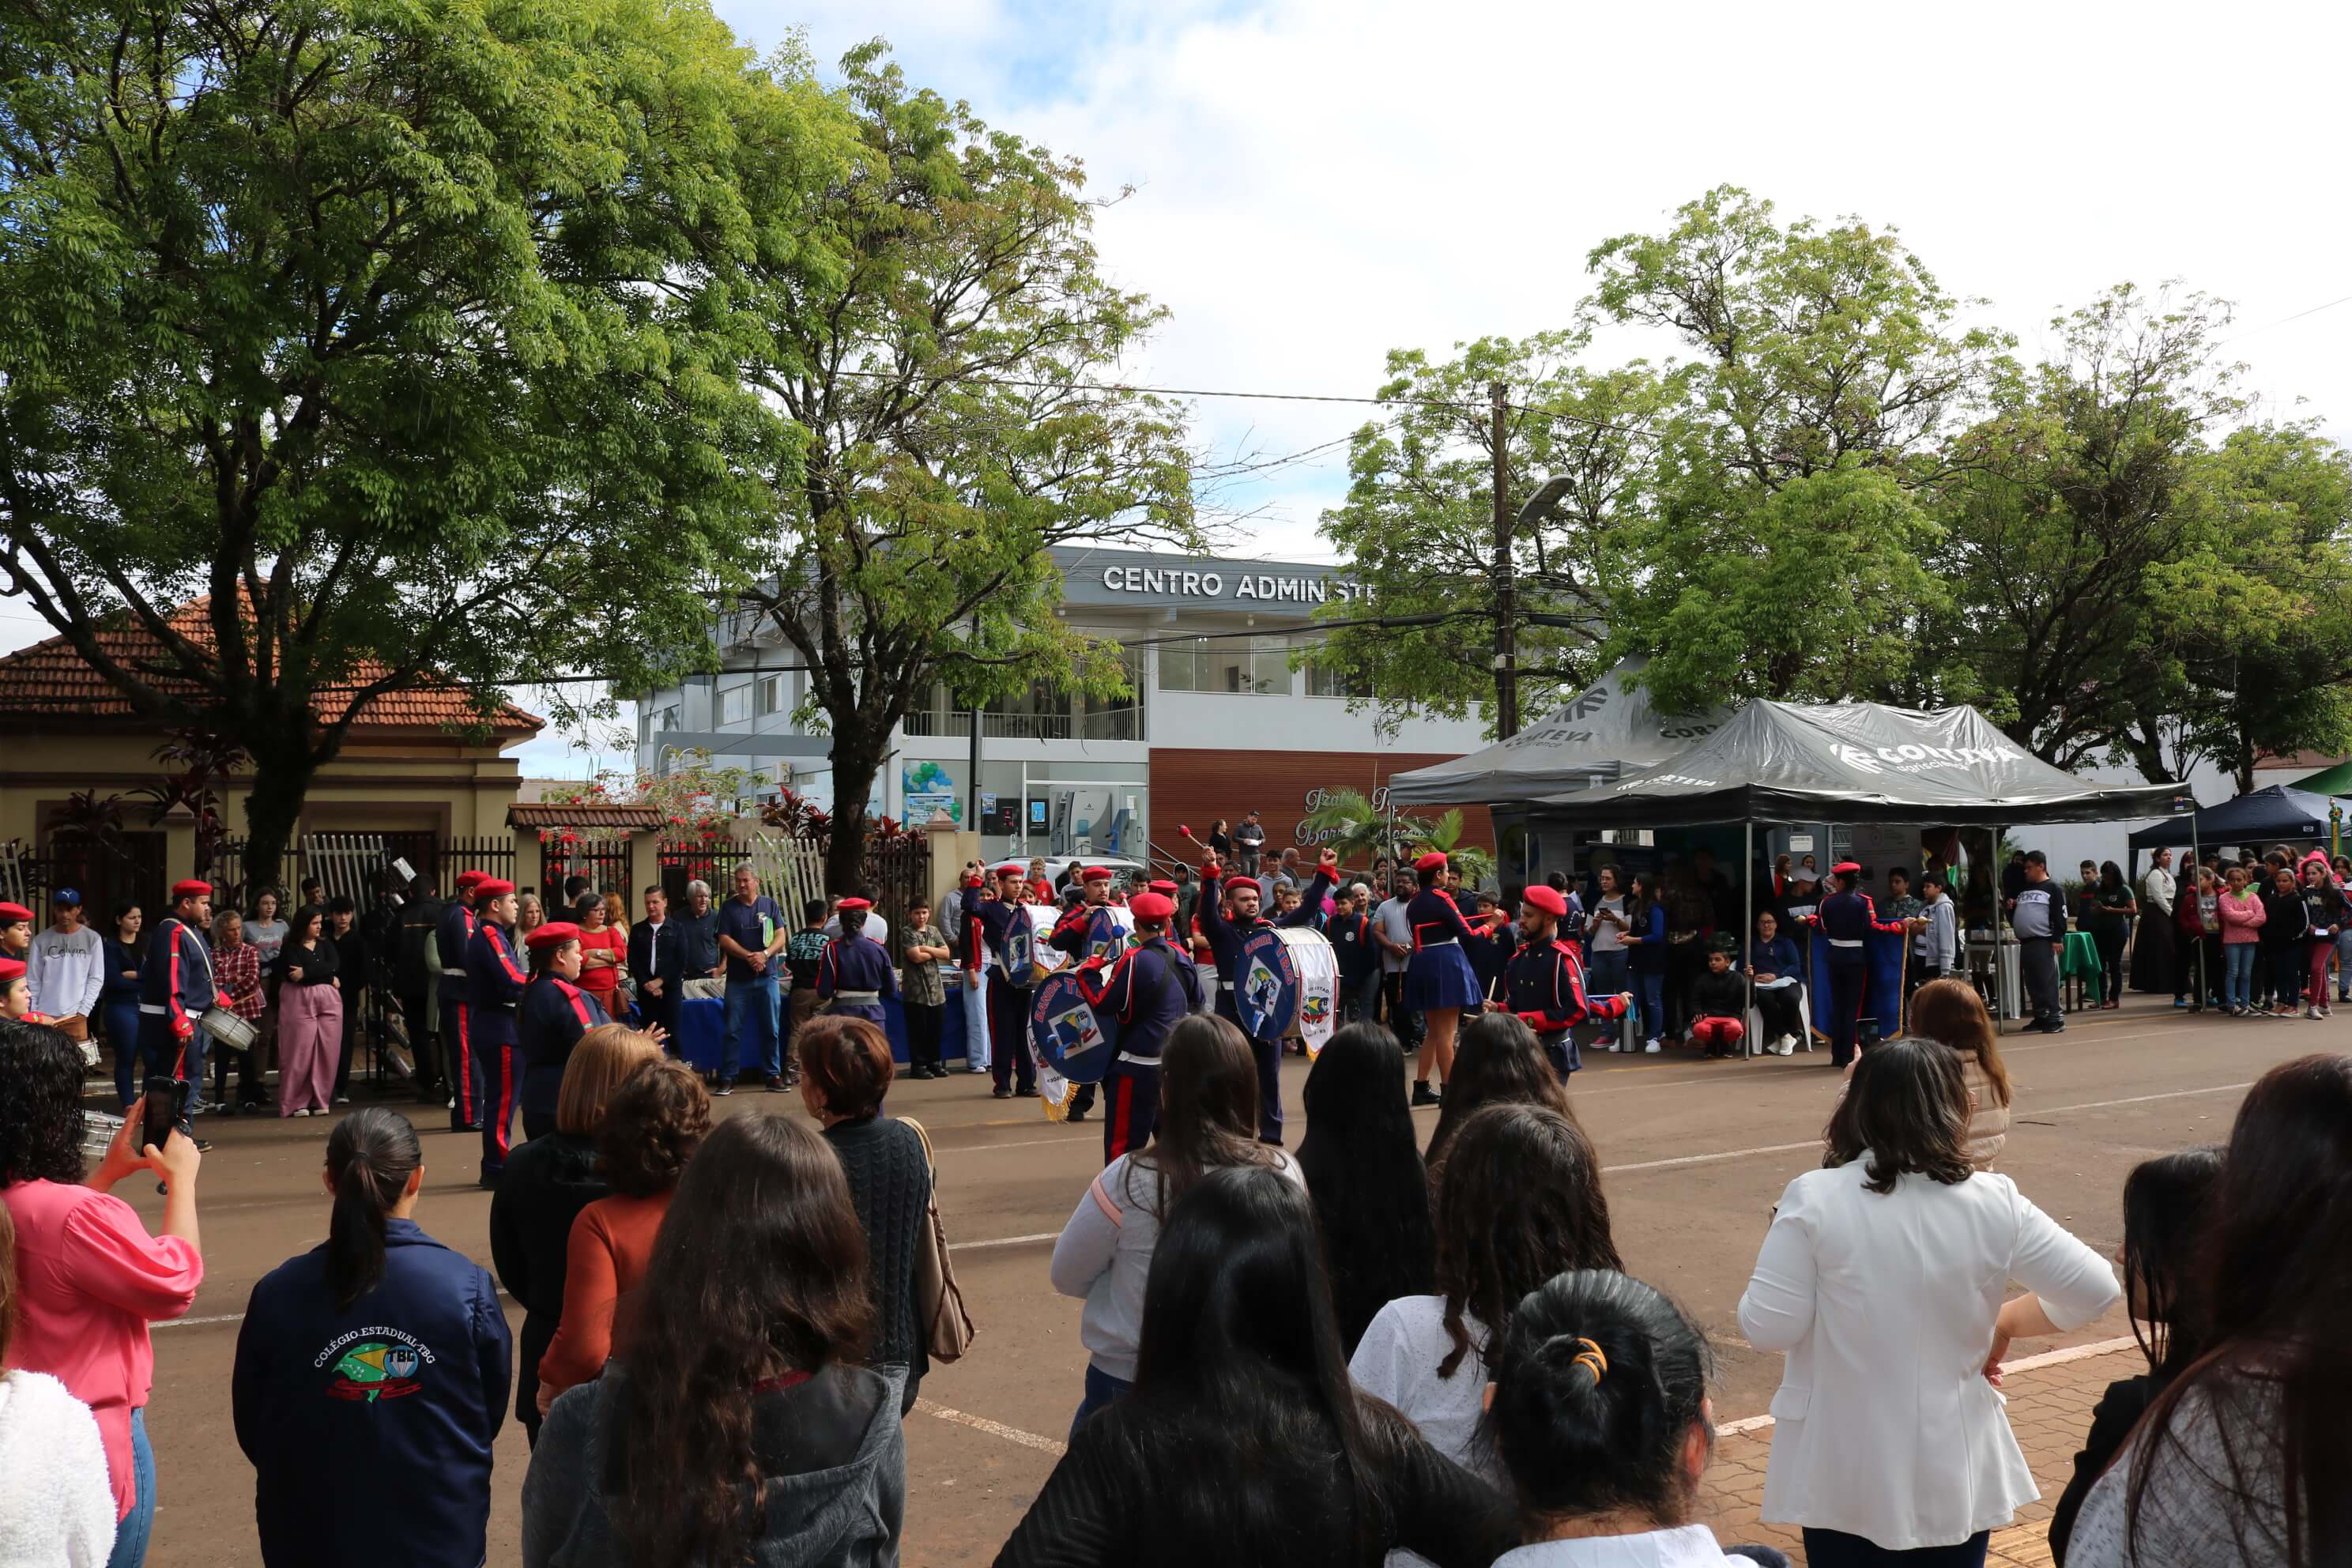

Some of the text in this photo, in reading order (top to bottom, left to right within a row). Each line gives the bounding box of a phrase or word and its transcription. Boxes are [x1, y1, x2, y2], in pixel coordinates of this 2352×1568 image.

[1103, 566, 1223, 596] CENTRO
[47, 941, 87, 959] Calvin
[1244, 933, 1274, 956] BANDA
[1276, 941, 1295, 986] TBG
[1034, 978, 1063, 1023] BANDA
[314, 1326, 435, 1367] COLÉGIO ESTADUAL TBG
[387, 1350, 415, 1363] TBG
